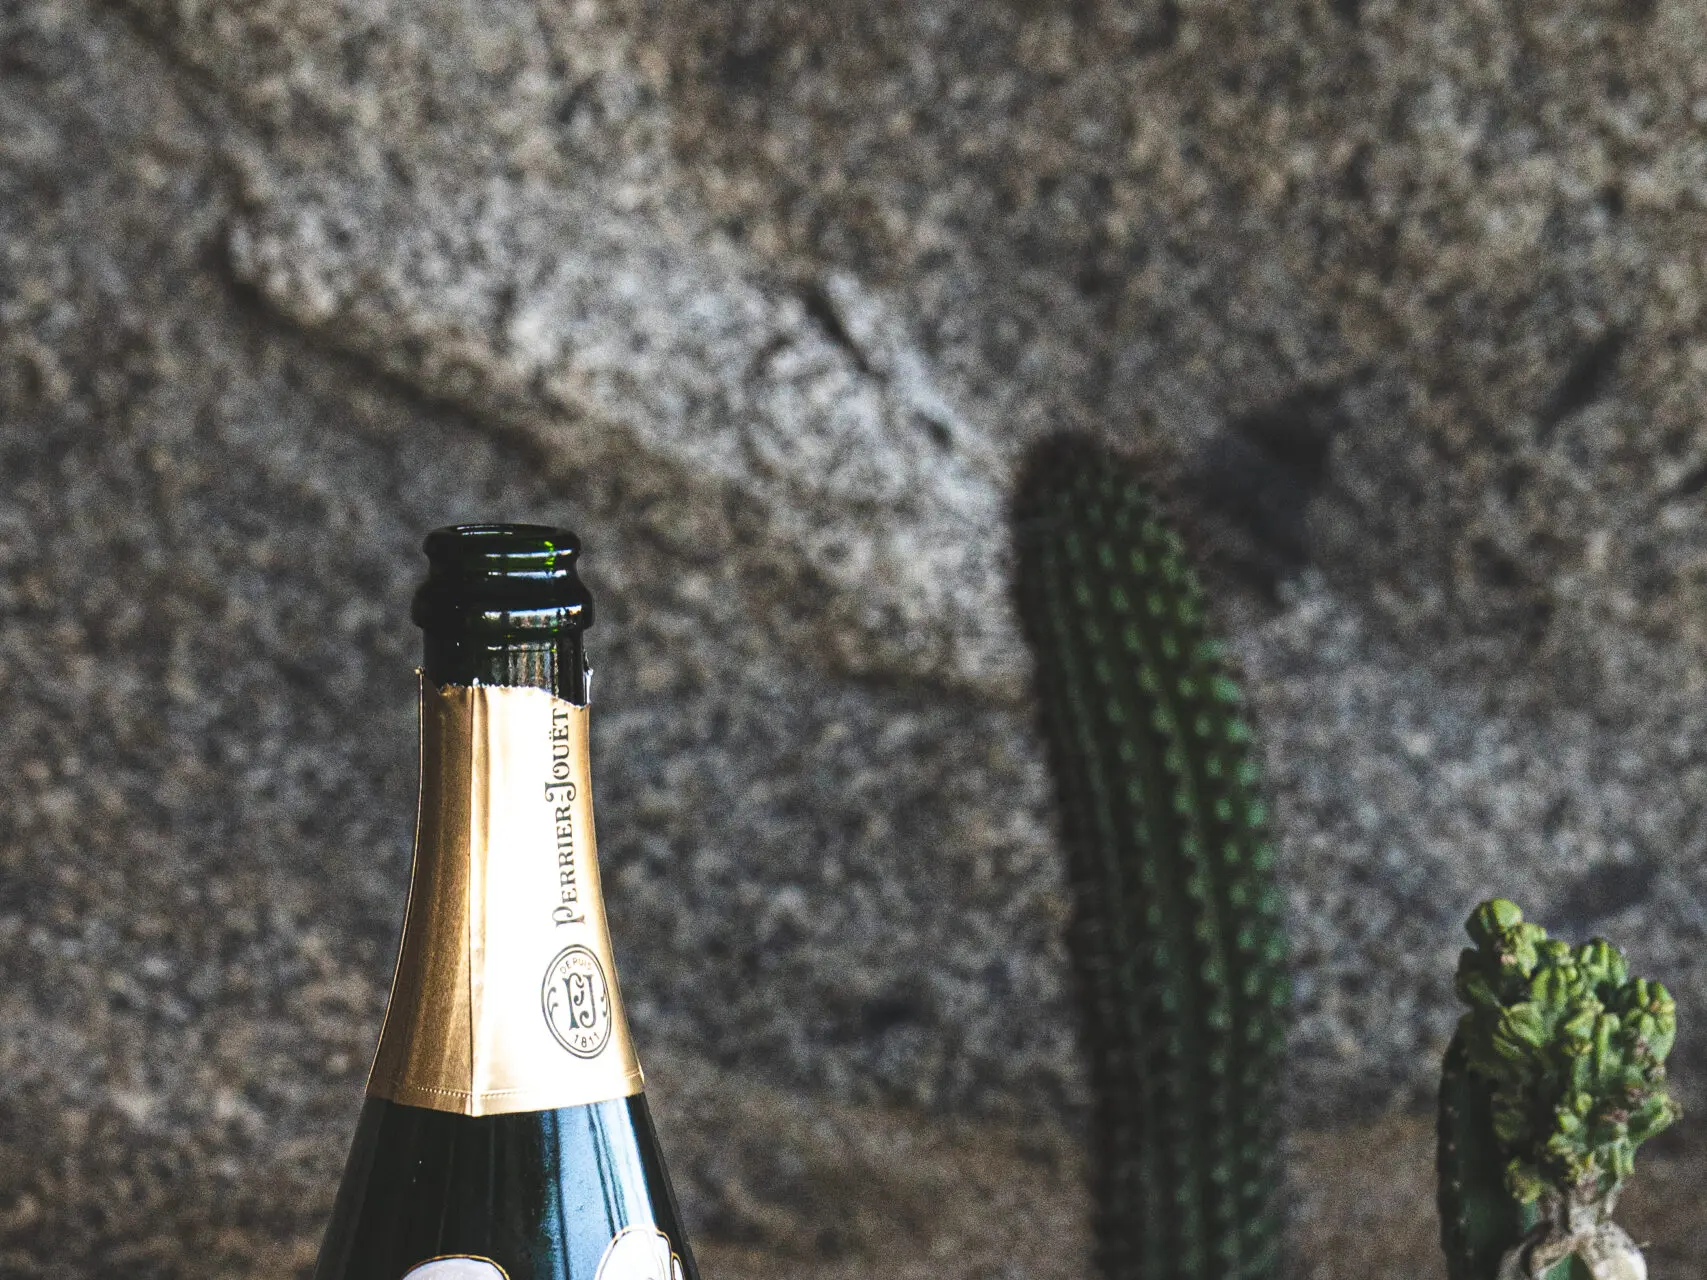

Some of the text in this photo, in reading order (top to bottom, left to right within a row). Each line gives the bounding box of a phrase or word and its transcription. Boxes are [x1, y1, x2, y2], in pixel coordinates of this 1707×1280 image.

[545, 708, 585, 928] PERRIER-JOUËT
[560, 957, 593, 975] DEPUIS
[574, 1031, 601, 1048] 1811
